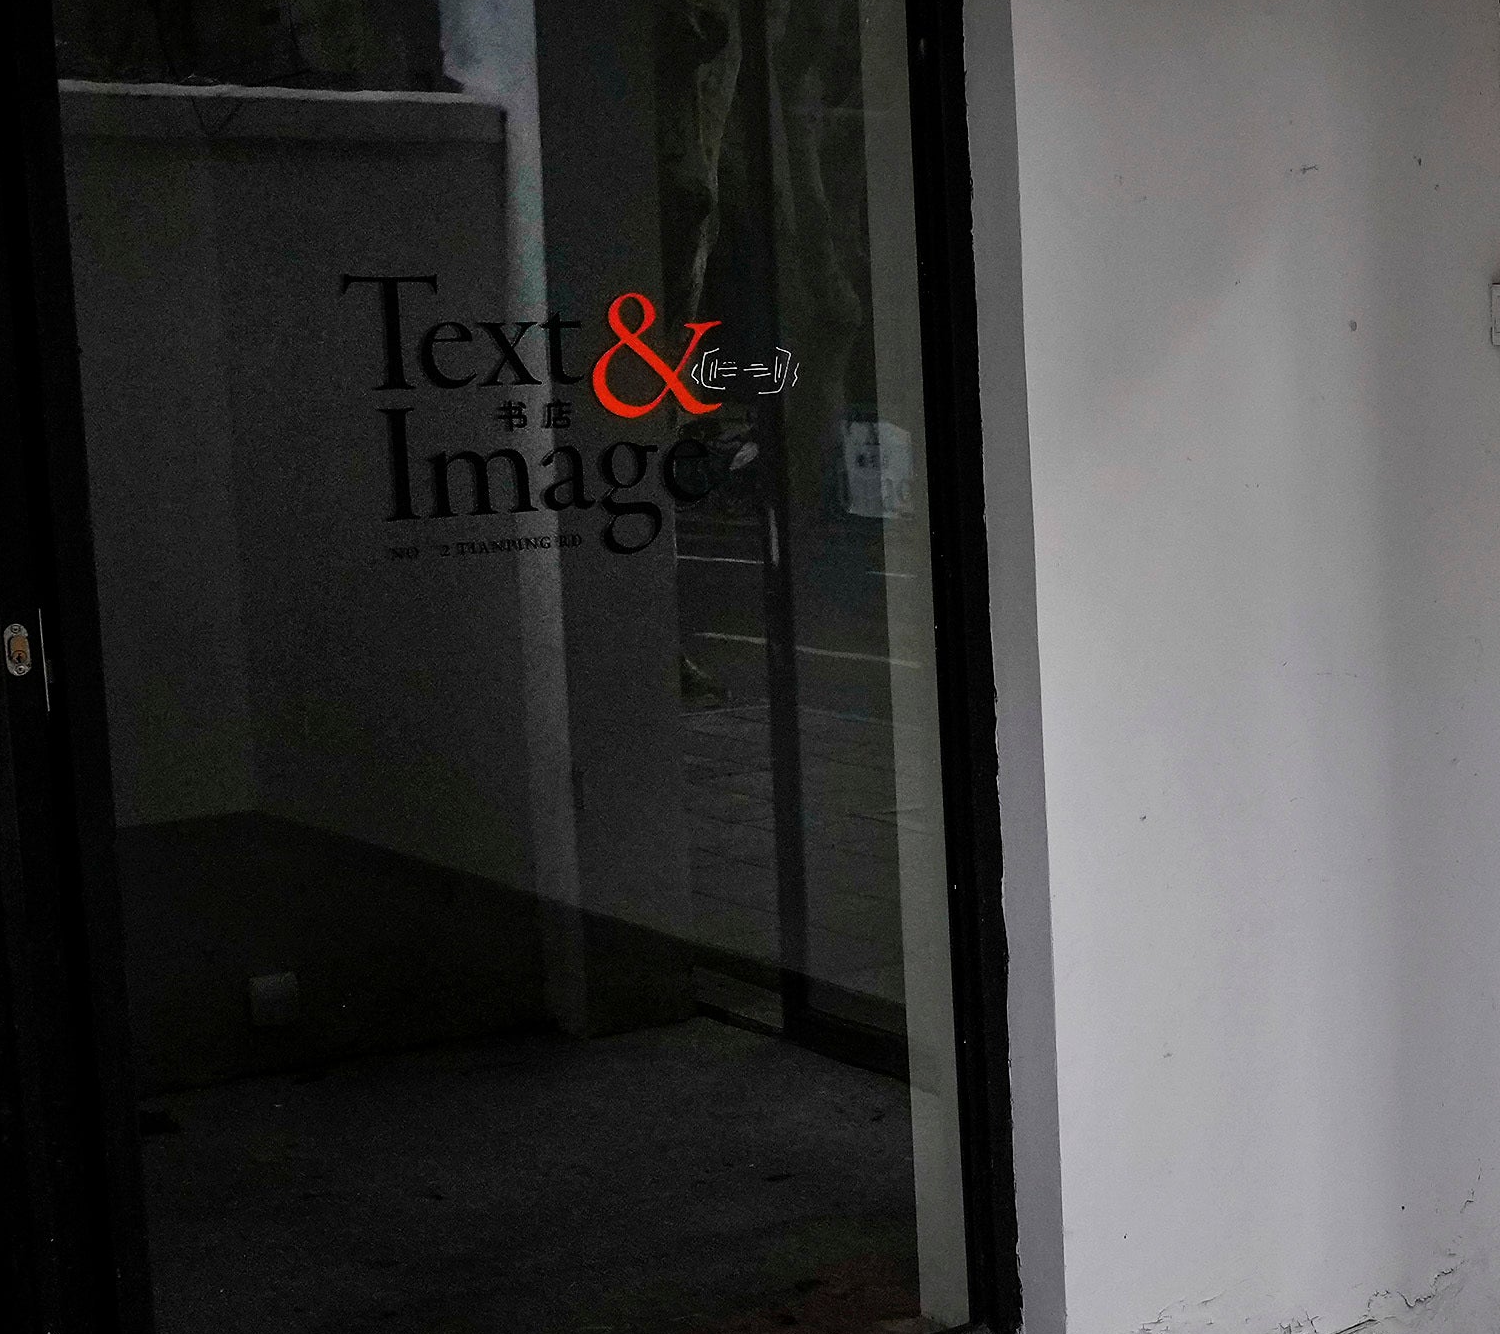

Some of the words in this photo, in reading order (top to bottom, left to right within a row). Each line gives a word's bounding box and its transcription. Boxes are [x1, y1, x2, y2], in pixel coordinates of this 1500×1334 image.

[340, 274, 583, 390] Text
[591, 292, 722, 418] &
[381, 408, 712, 554] Image
[456, 536, 551, 556] TIANPING
